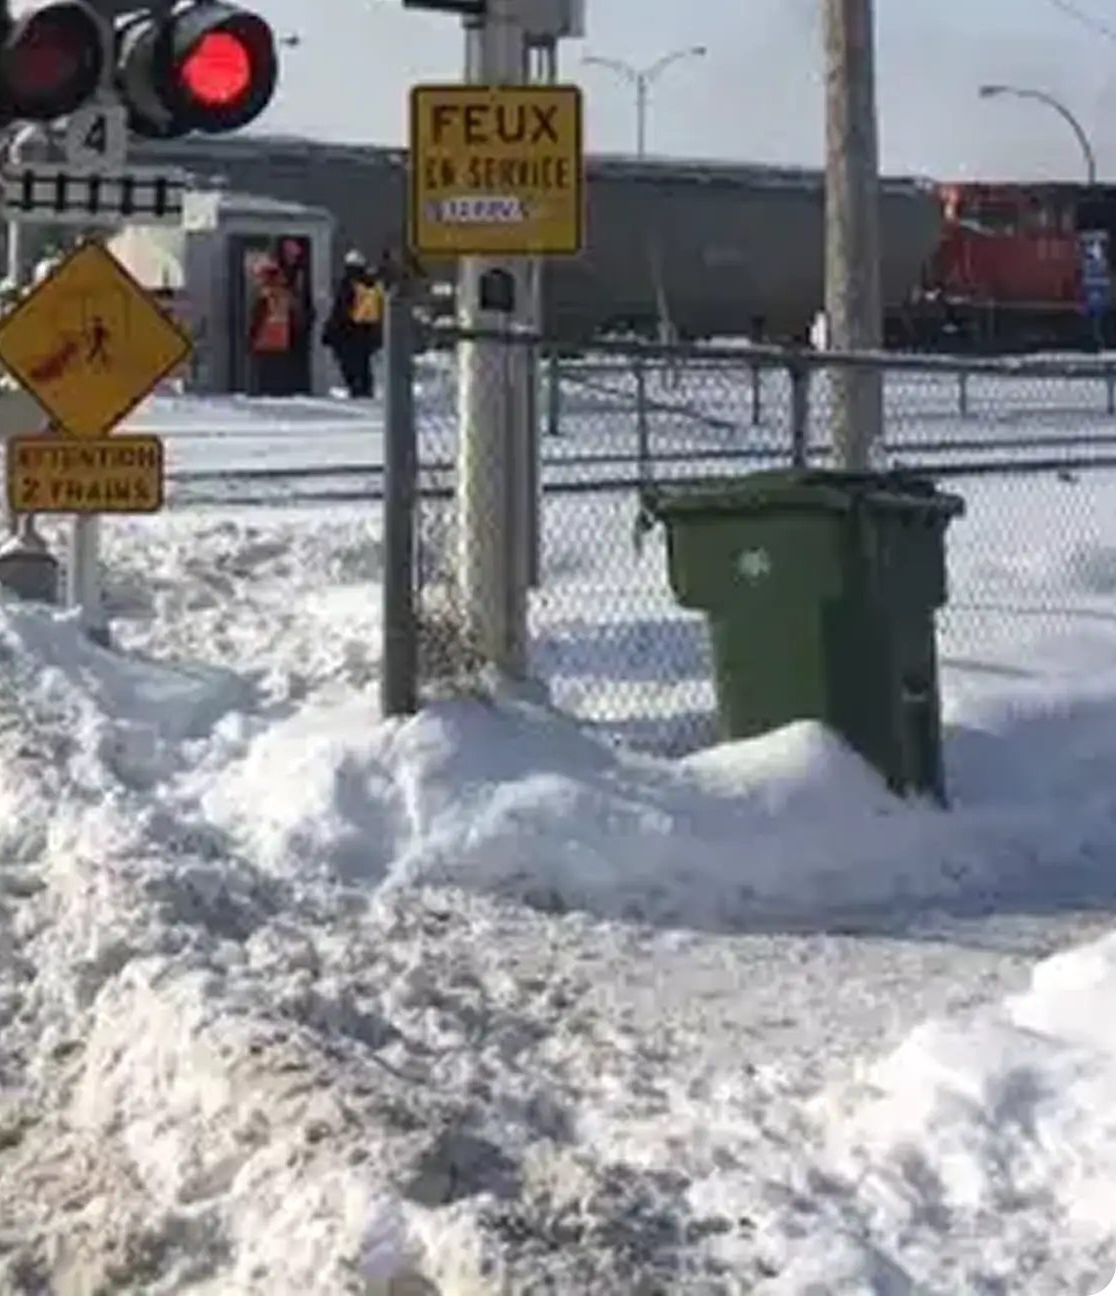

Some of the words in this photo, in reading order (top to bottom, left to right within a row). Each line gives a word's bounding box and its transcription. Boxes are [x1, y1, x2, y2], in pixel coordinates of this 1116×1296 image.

[85, 115, 107, 155] 4
[431, 105, 559, 146] FEUX
[468, 157, 571, 189] SERVICE
[22, 476, 40, 503] 2
